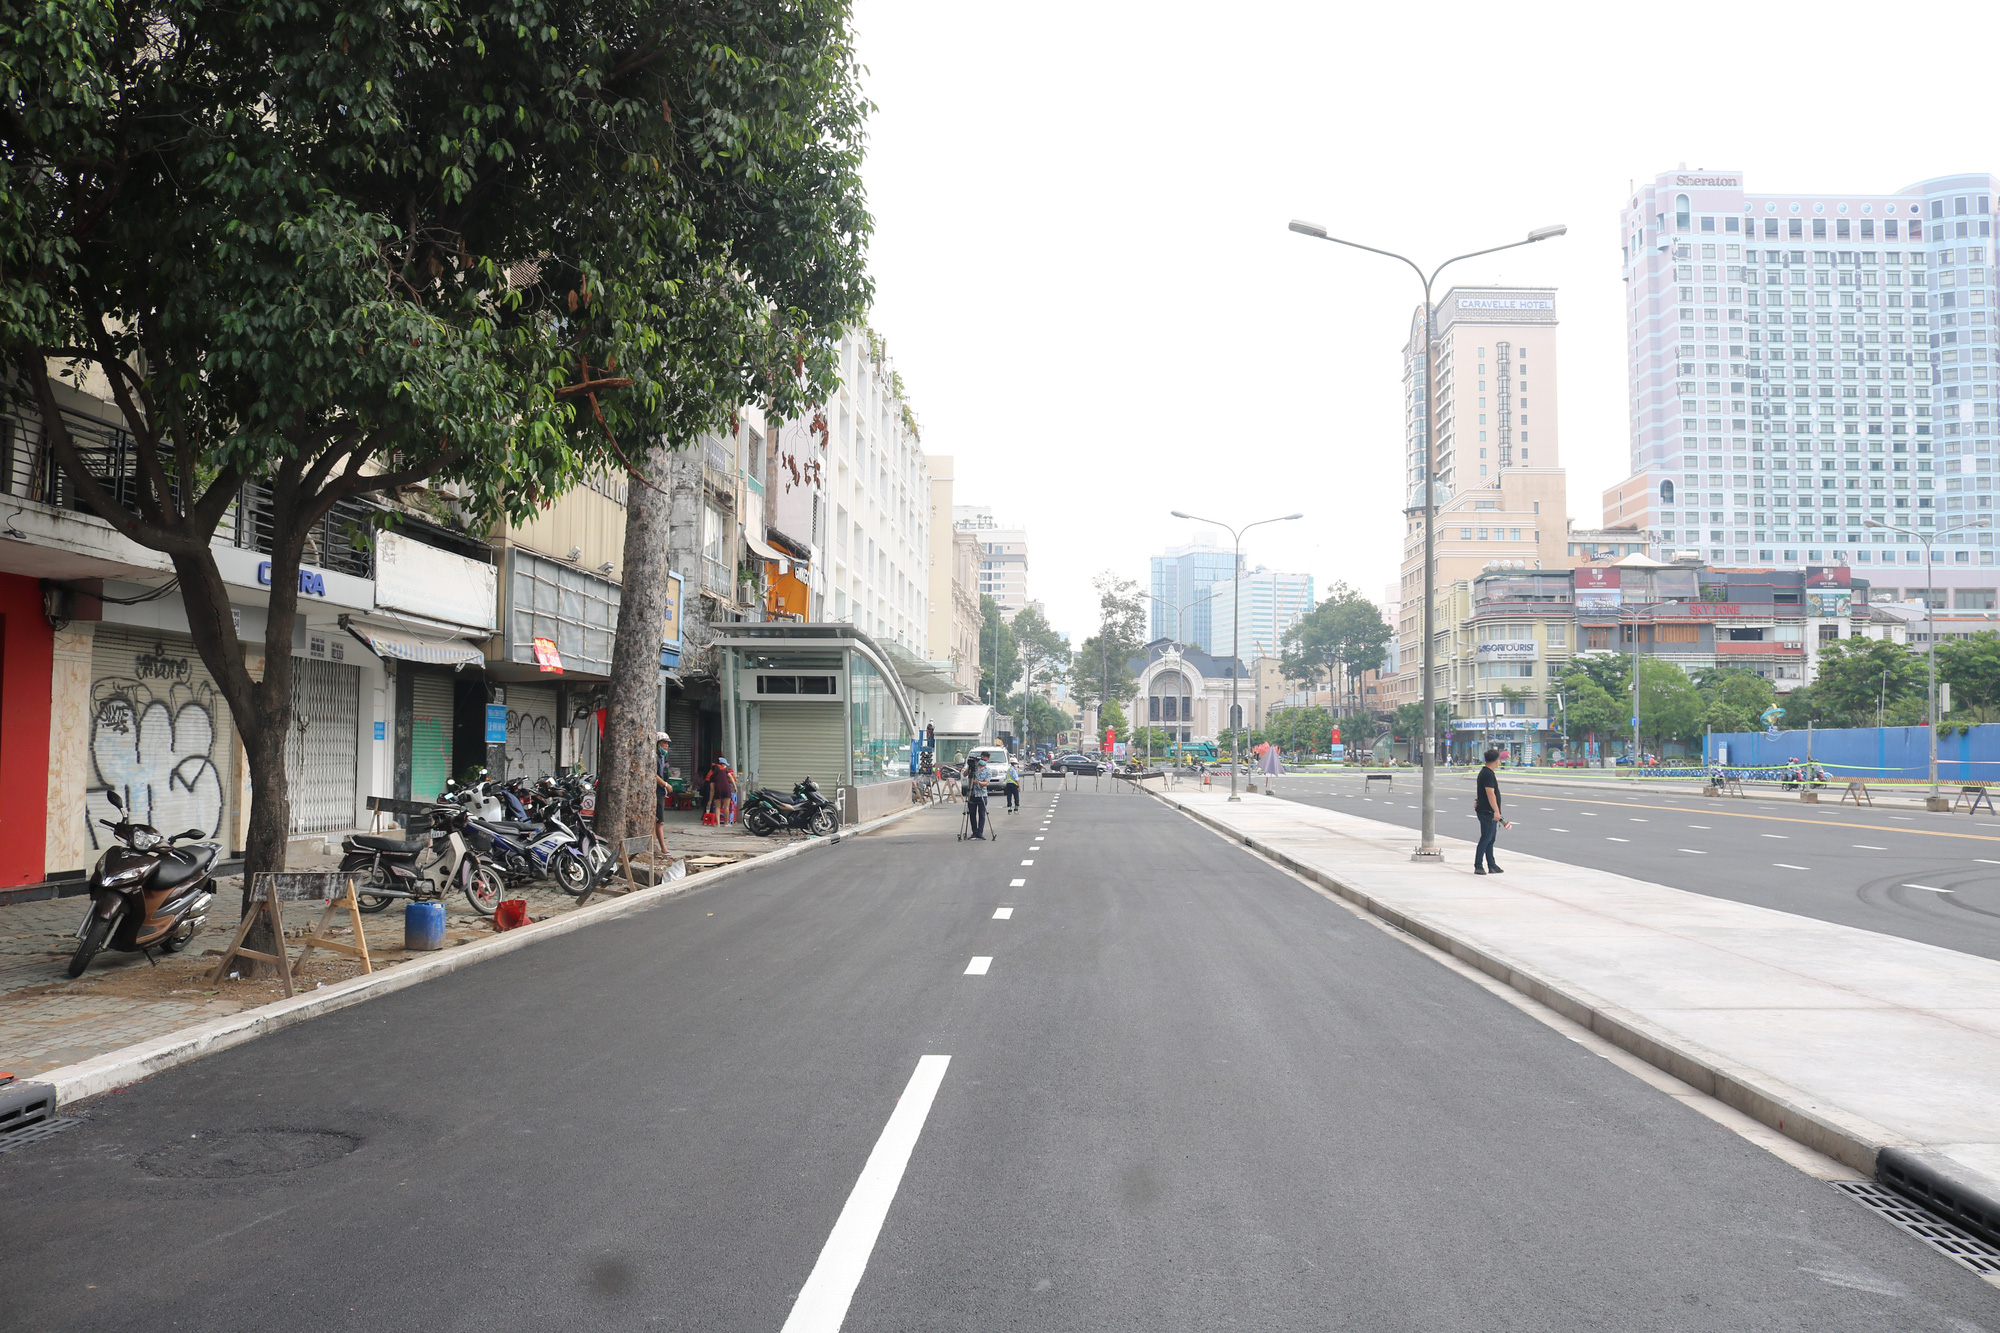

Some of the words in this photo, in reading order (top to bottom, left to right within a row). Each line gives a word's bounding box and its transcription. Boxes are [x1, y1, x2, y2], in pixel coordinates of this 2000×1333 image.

[1676, 174, 1737, 187] Sheraton
[1461, 300, 1516, 309] CARAVELLE
[1520, 301, 1551, 309] HOTEL
[1690, 604, 1711, 615] SKY
[1713, 604, 1741, 615] ZONE
